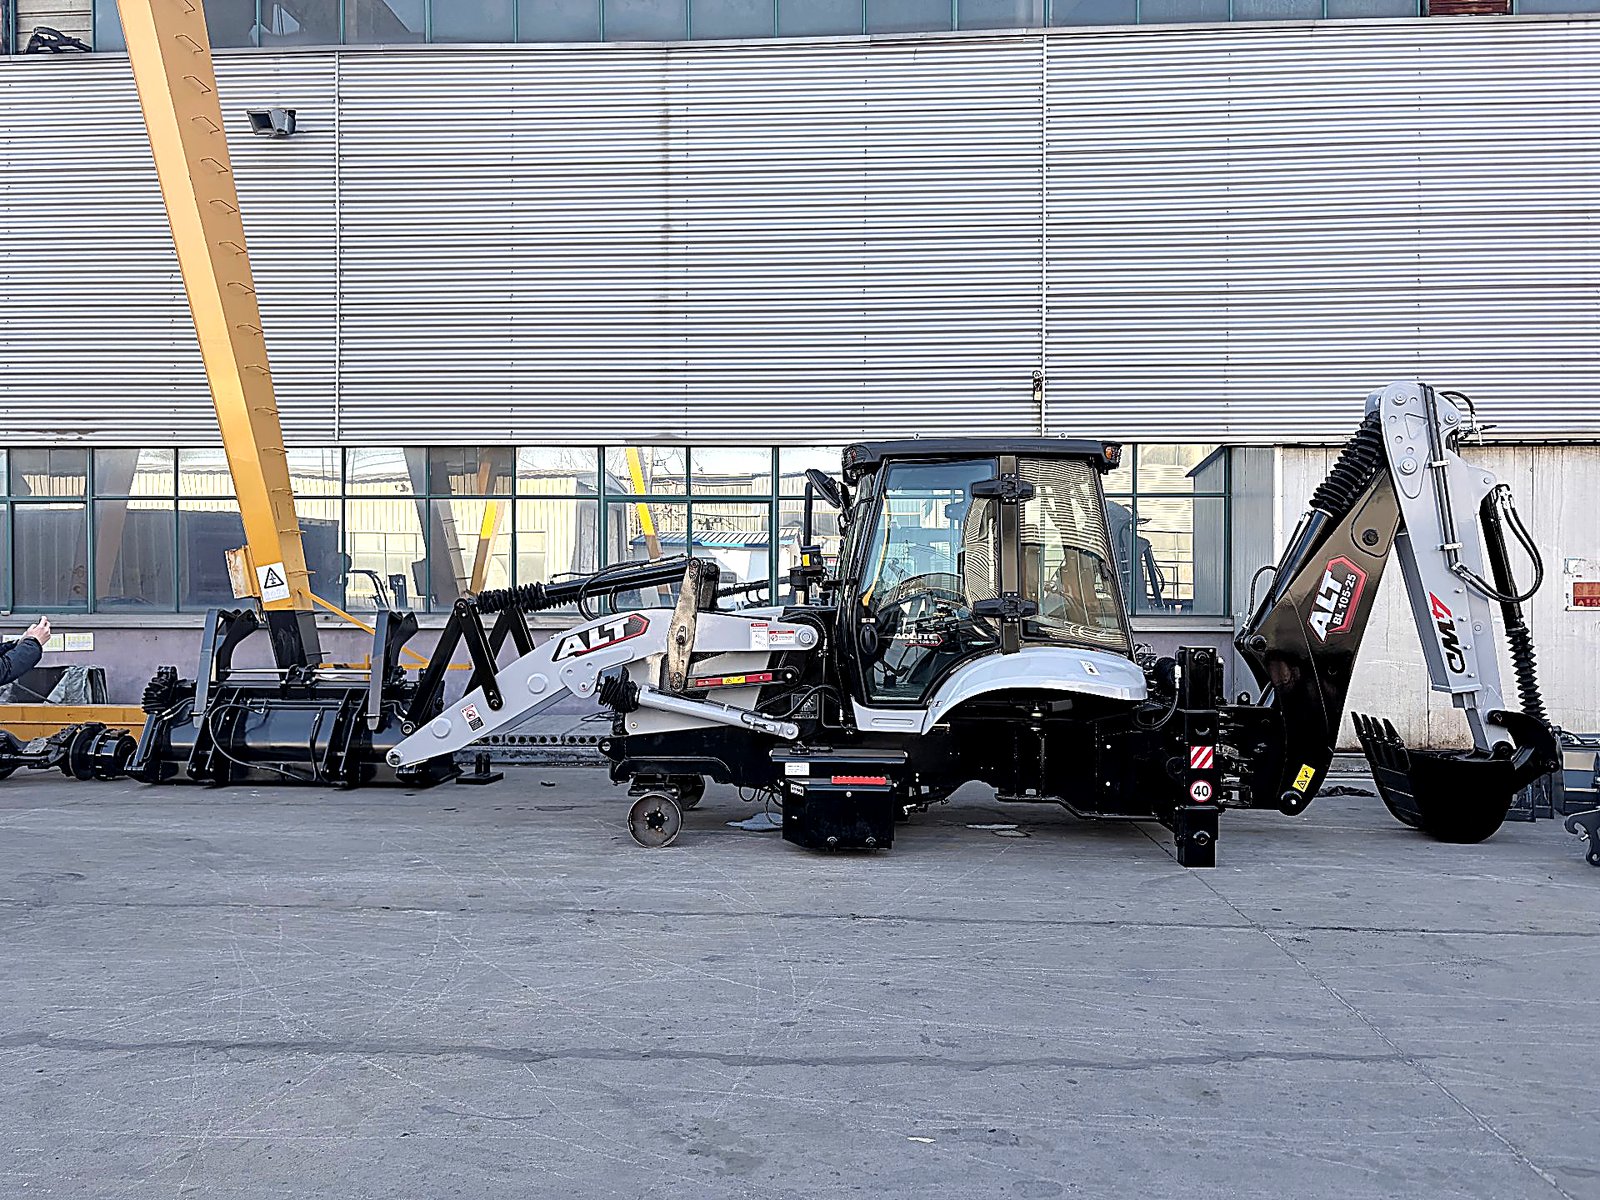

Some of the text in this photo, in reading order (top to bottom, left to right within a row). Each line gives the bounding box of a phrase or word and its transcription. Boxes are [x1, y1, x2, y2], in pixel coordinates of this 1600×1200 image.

[1309, 569, 1342, 642] ALT
[1332, 573, 1357, 626] BL 105-25
[556, 617, 630, 661] ALT
[1428, 591, 1466, 674] 4WD
[1193, 785, 1209, 797] 40
